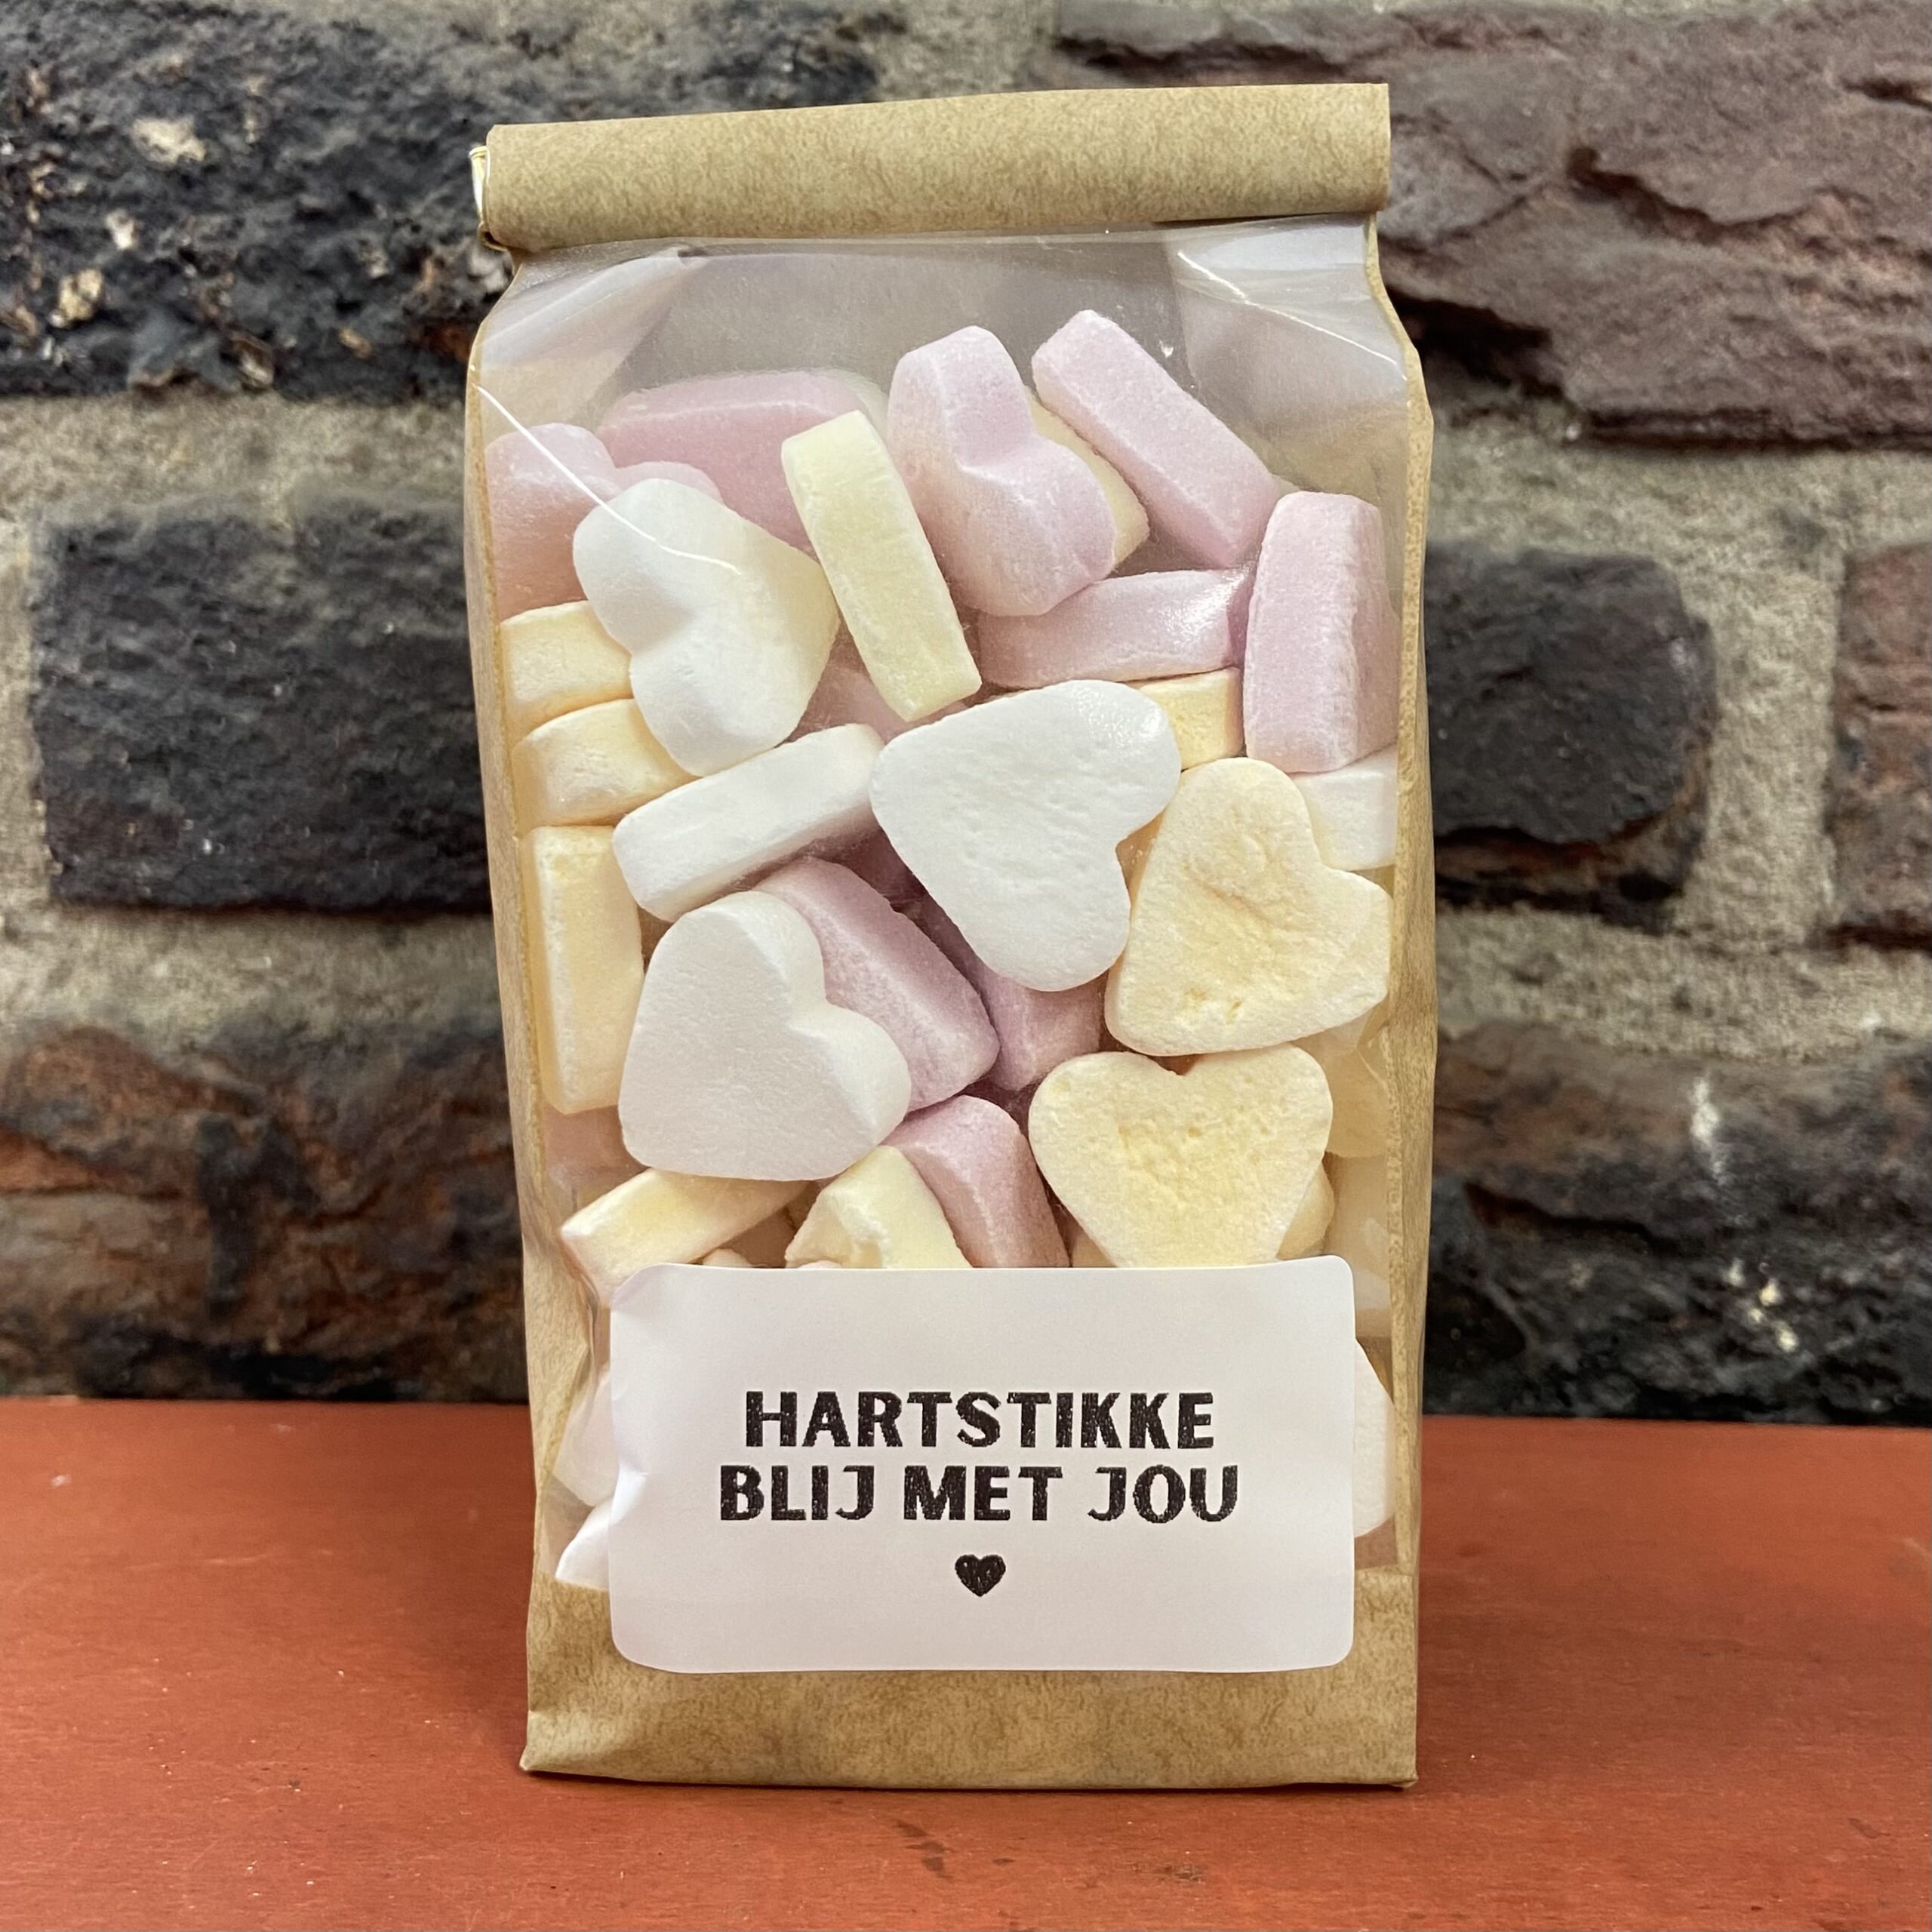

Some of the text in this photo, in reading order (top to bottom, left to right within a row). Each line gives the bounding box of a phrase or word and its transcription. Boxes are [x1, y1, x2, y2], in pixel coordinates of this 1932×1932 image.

[745, 1390, 1215, 1450] HARTSTIKKE
[720, 1464, 1238, 1524] BLIJ MET JOU
